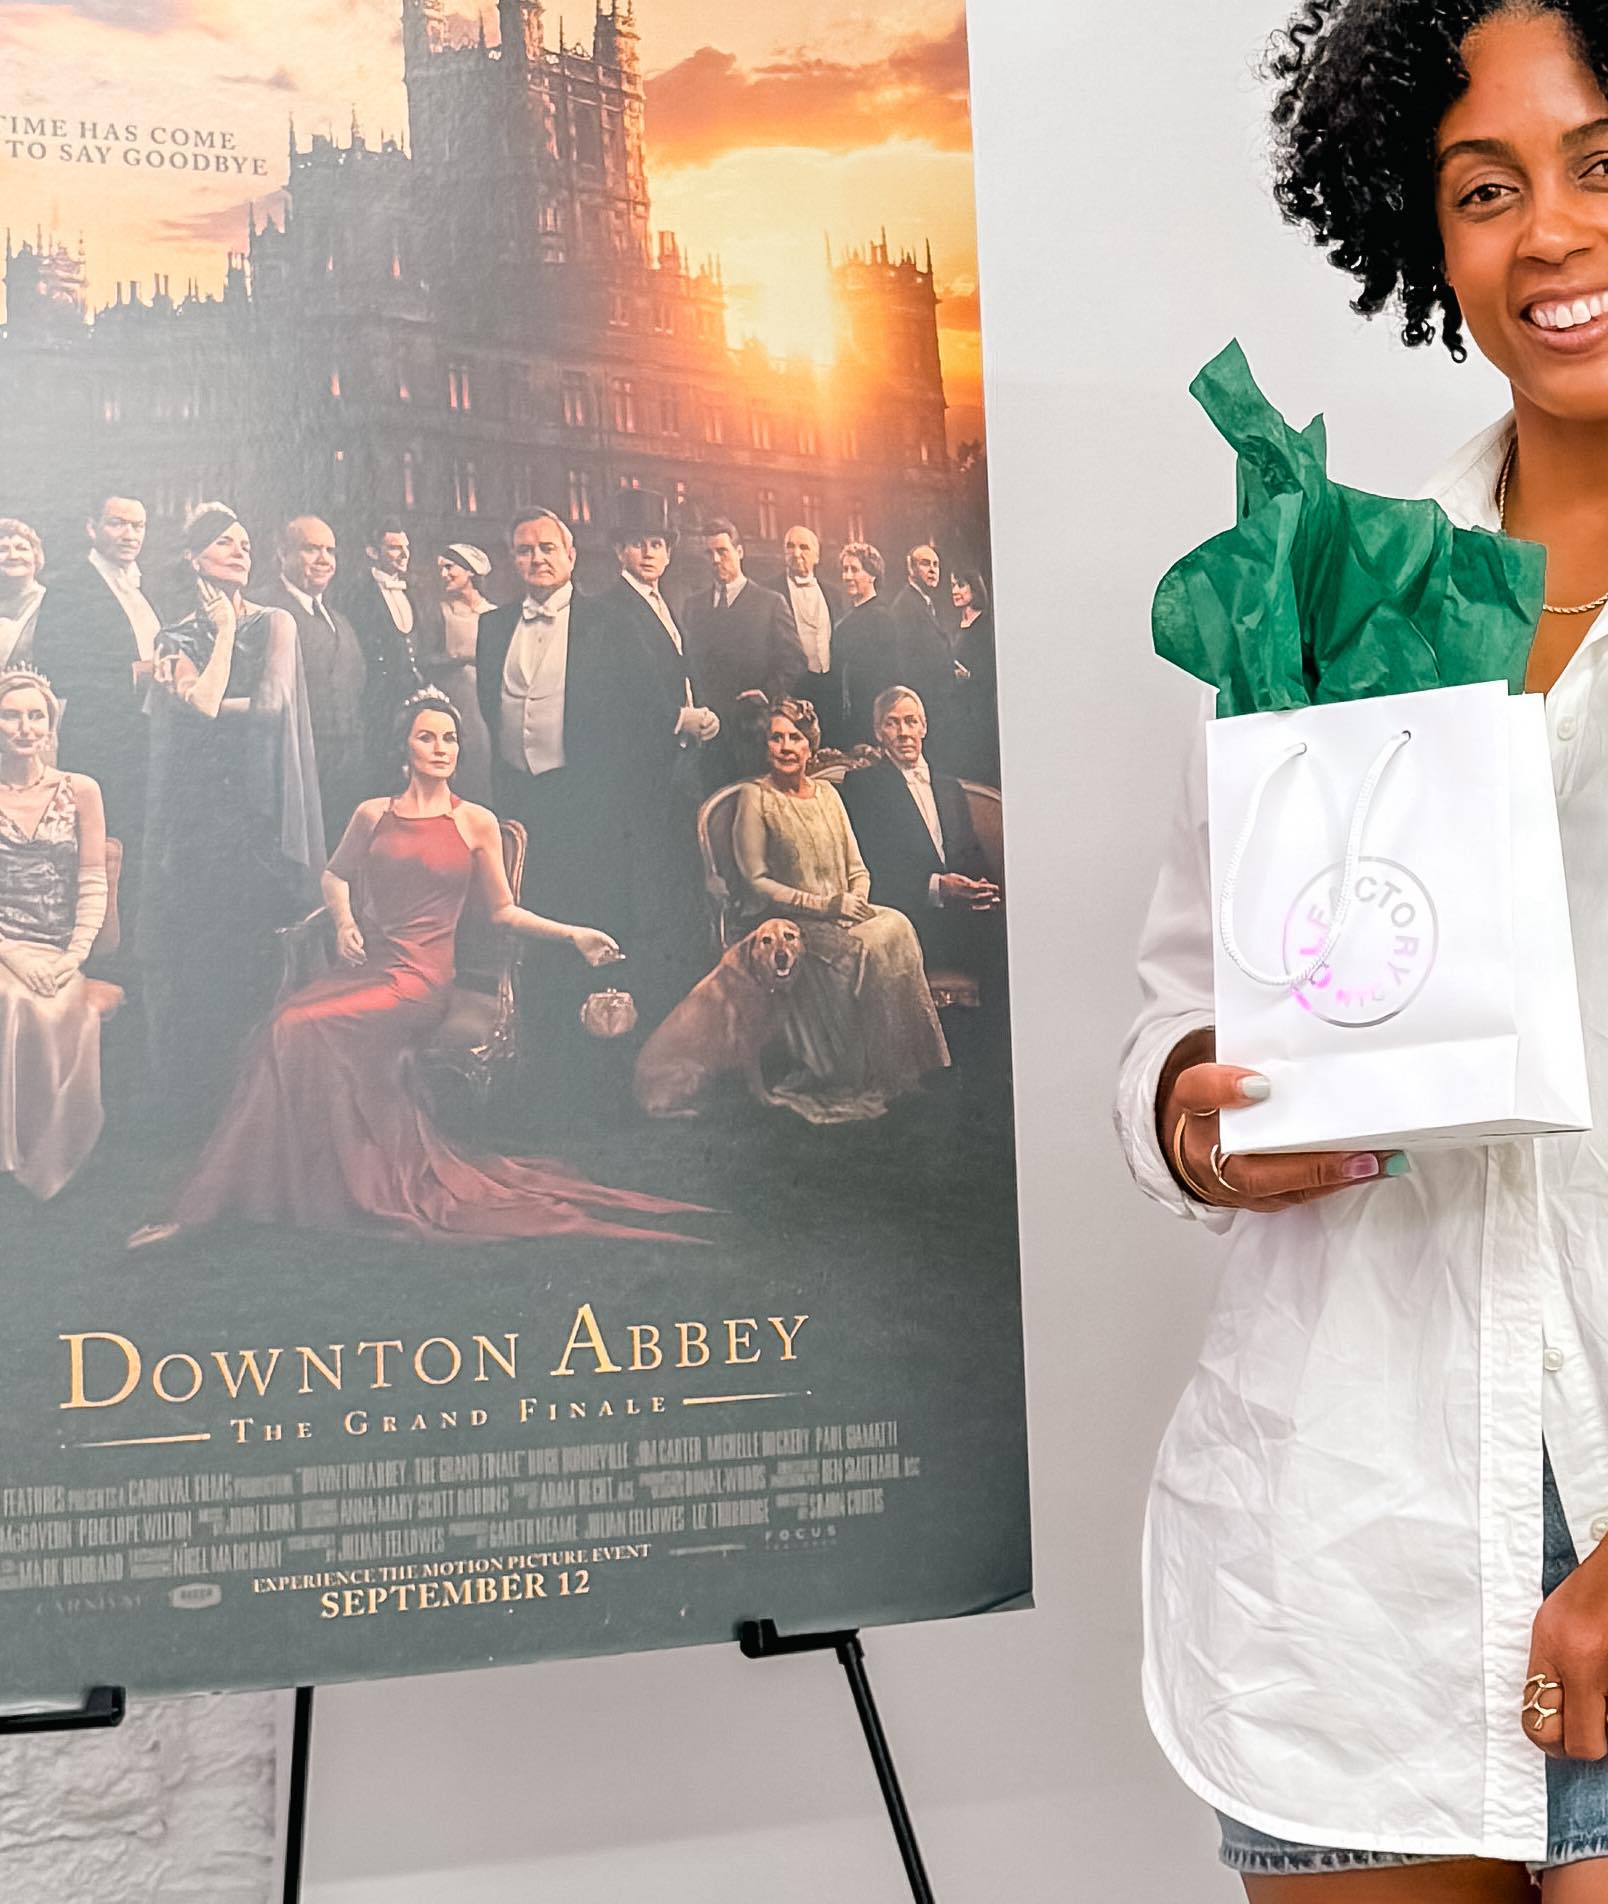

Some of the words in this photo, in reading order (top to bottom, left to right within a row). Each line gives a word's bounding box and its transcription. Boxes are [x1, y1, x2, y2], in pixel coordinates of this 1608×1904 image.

[5, 139, 47, 161] TO
[59, 143, 112, 165] SAY
[122, 148, 268, 177] GOODBYE
[80, 120, 138, 143] HAS
[150, 127, 237, 152] COME
[59, 1331, 520, 1409] DOWNTON
[549, 1303, 810, 1377] ABBEY
[230, 1417, 312, 1444] THE
[343, 1410, 488, 1436] GRAND
[519, 1397, 666, 1424] FINALE
[764, 1525, 837, 1542] FOCUS
[254, 1568, 377, 1594] EXPERIENCE
[379, 1564, 415, 1582] THE
[423, 1556, 503, 1578] MOTION
[507, 1549, 588, 1570] PICTURE
[592, 1544, 652, 1563] EVENT
[320, 1572, 548, 1620] SEPTEMBER
[558, 1569, 591, 1597] 12
